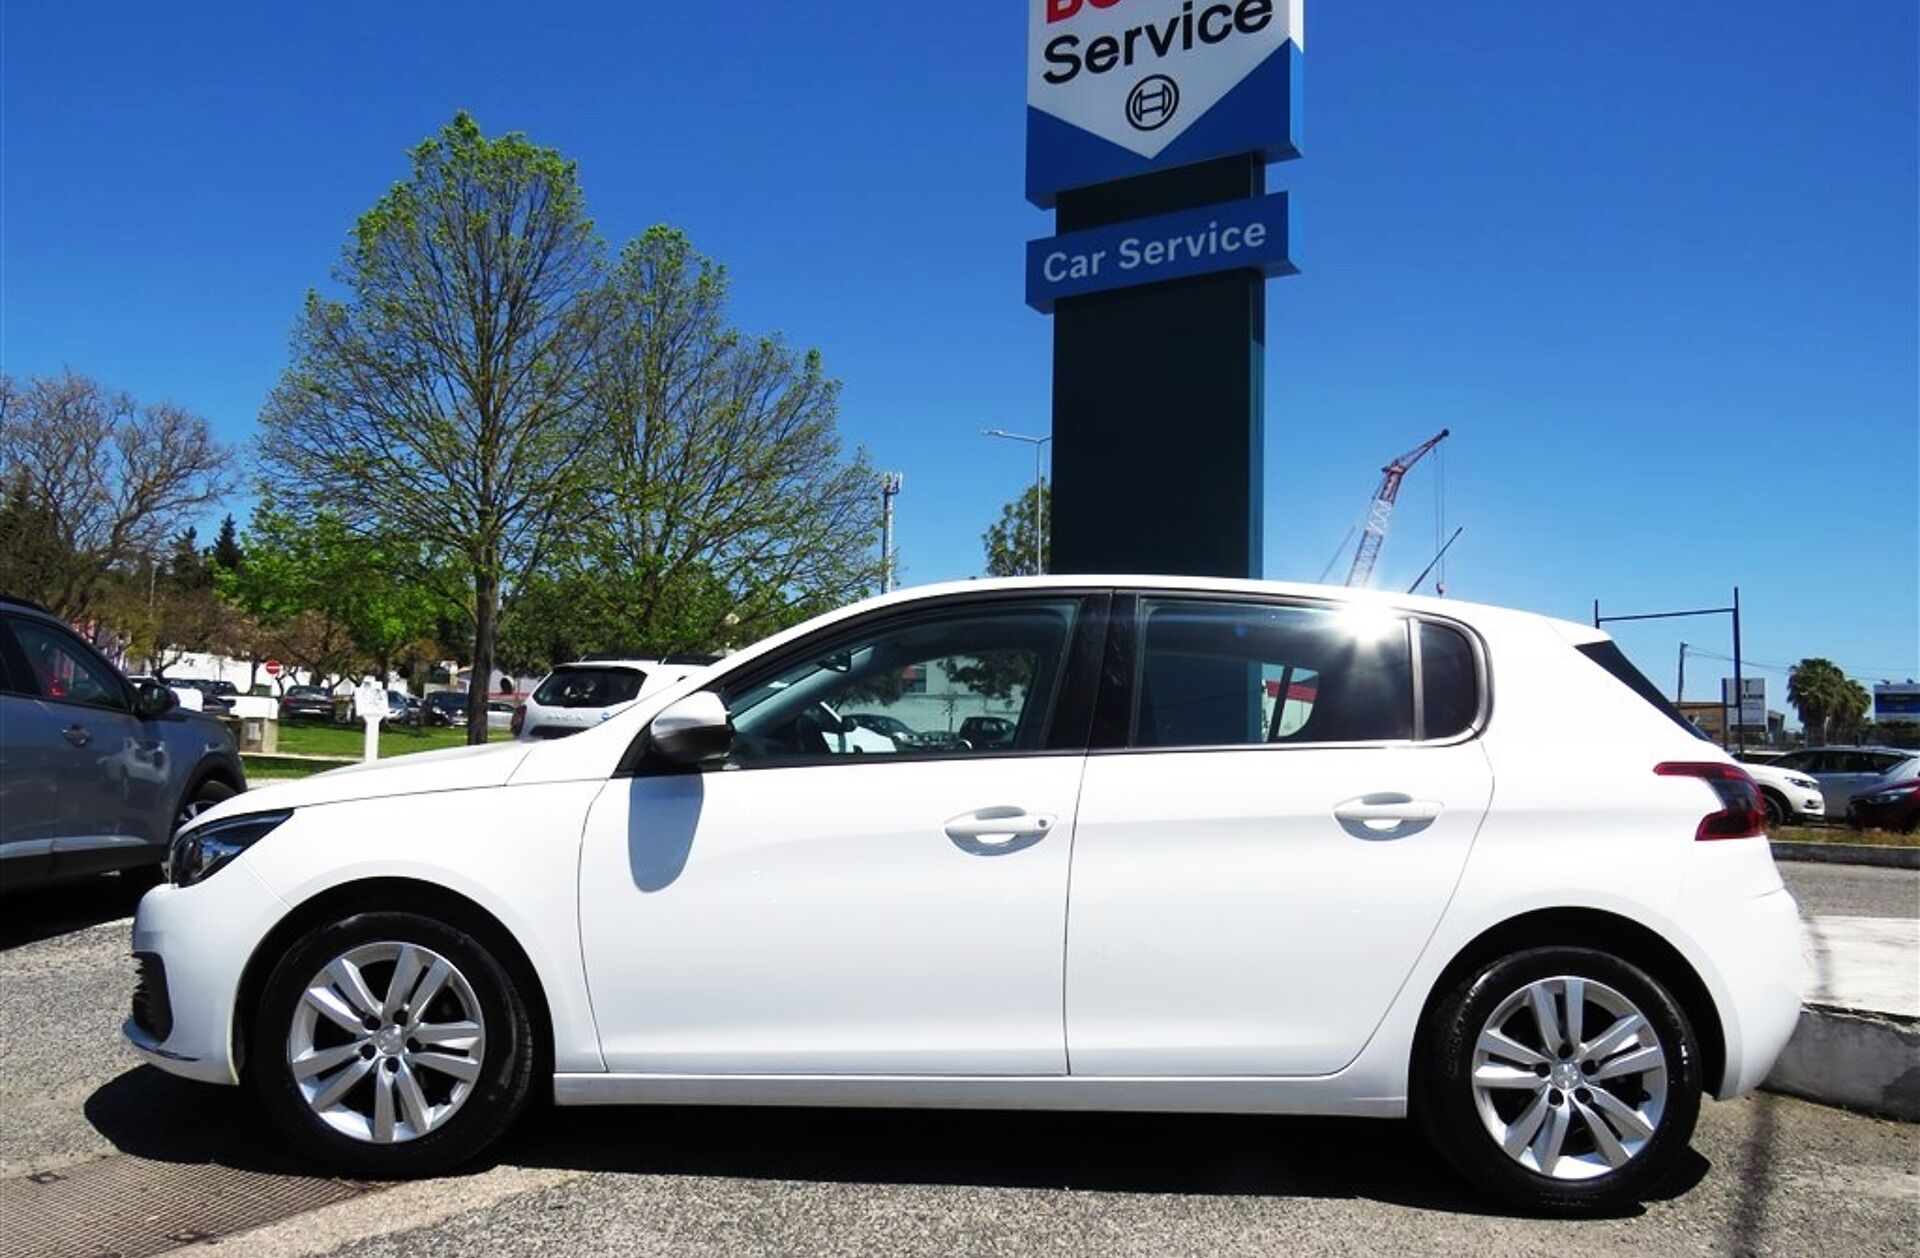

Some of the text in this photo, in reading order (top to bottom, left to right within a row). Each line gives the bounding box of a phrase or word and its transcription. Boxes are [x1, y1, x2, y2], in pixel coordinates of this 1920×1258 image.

[1043, 0, 1273, 84] Service
[1043, 221, 1267, 282] Car Service
